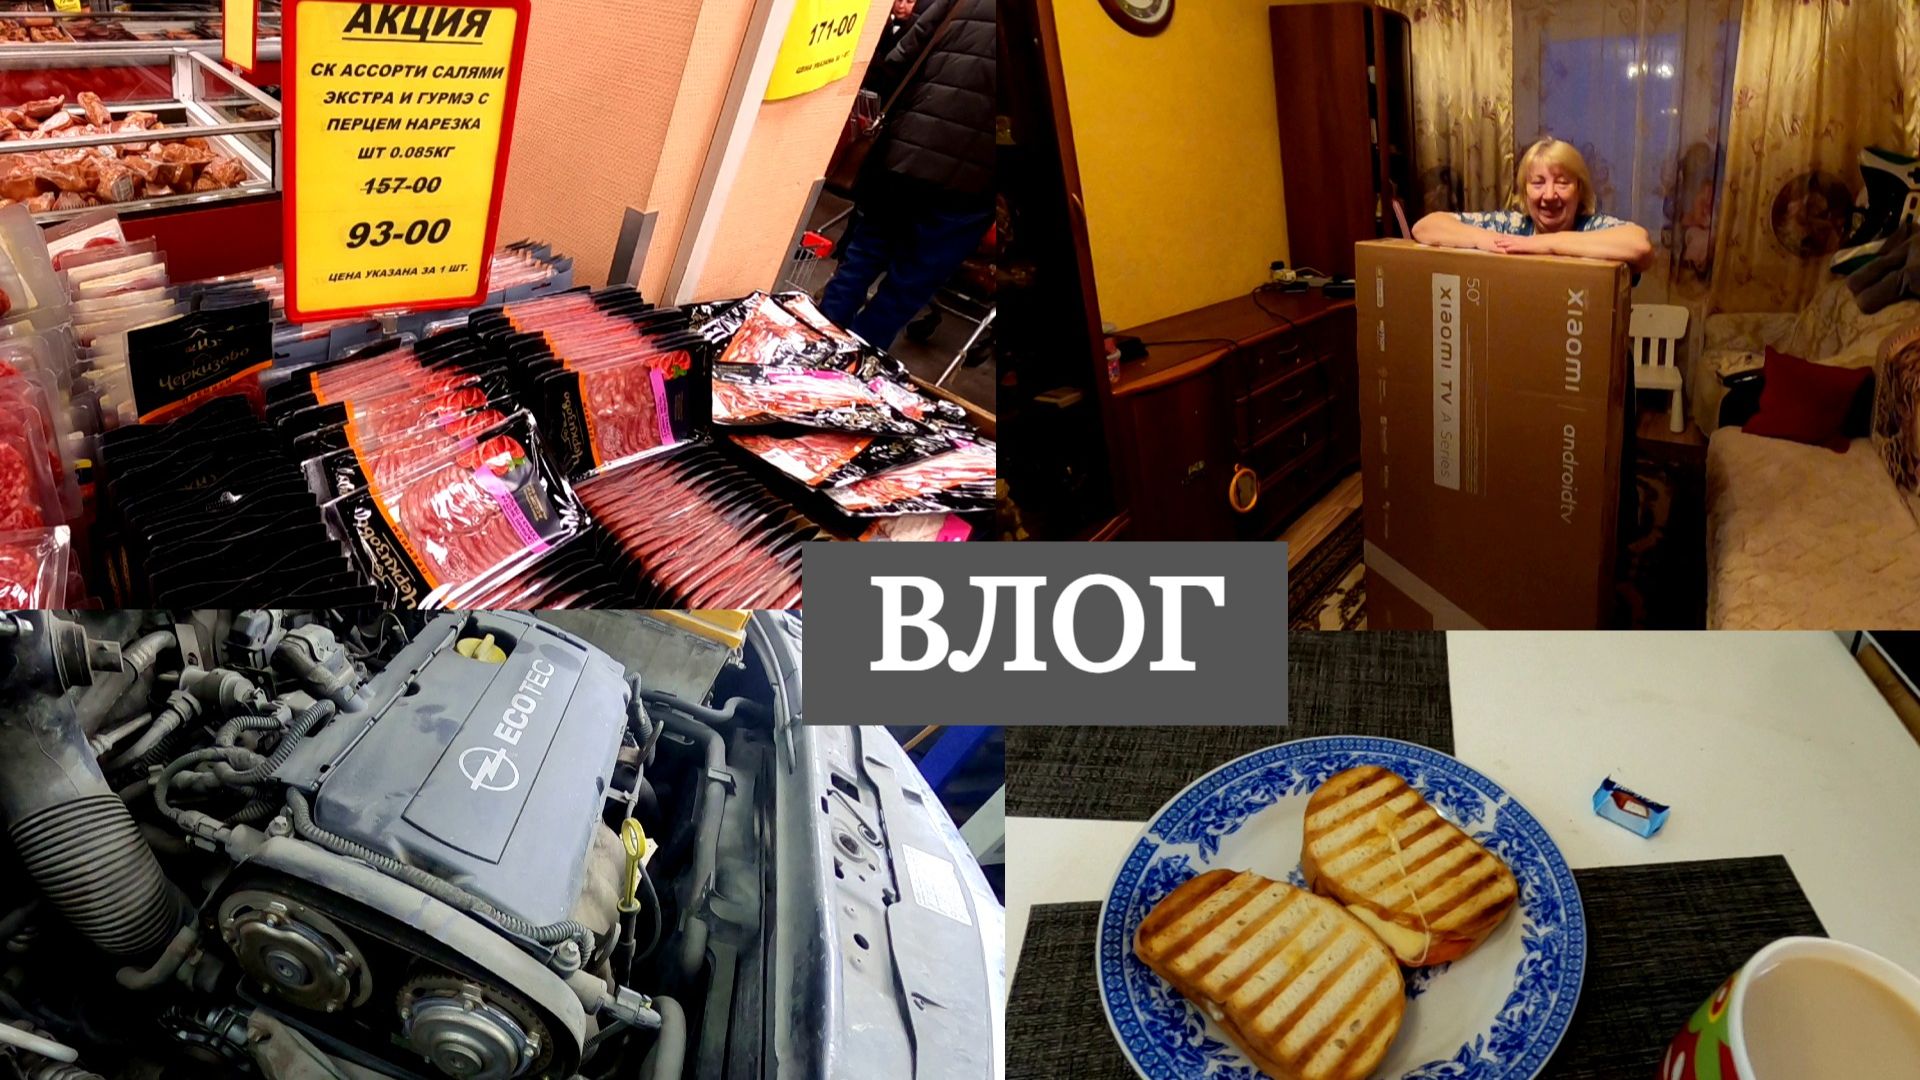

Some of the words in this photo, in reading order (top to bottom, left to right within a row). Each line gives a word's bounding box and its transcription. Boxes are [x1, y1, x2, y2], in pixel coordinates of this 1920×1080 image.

[342, 3, 492, 41] АКЦИЯ
[809, 13, 857, 46] 171-00
[310, 63, 337, 77] СК
[340, 63, 428, 78] АССОРТИ
[432, 65, 505, 79] САЛЯМИ
[323, 91, 394, 105] ЭКСТРА
[399, 92, 413, 104] И
[417, 92, 473, 105] ГУРМЭ
[478, 93, 489, 105] С
[326, 118, 401, 132] ПЕРЦЕМ
[405, 118, 481, 131] НАРЕЗКА
[357, 147, 386, 159] ШТ
[389, 146, 455, 159] 0.085КГ
[362, 176, 442, 194] 157-00
[346, 218, 451, 249] 93-00
[328, 270, 362, 282] ЦЕНА
[365, 266, 418, 279] УКАЗАНА
[421, 265, 438, 275] ЗА
[440, 265, 446, 274] 1
[449, 263, 469, 274] ШТ.
[159, 347, 250, 390] Черкизово
[1440, 381, 1453, 405] TV
[1441, 412, 1452, 423] A
[1440, 430, 1453, 478] Series
[493, 659, 555, 746] ECOTEC
